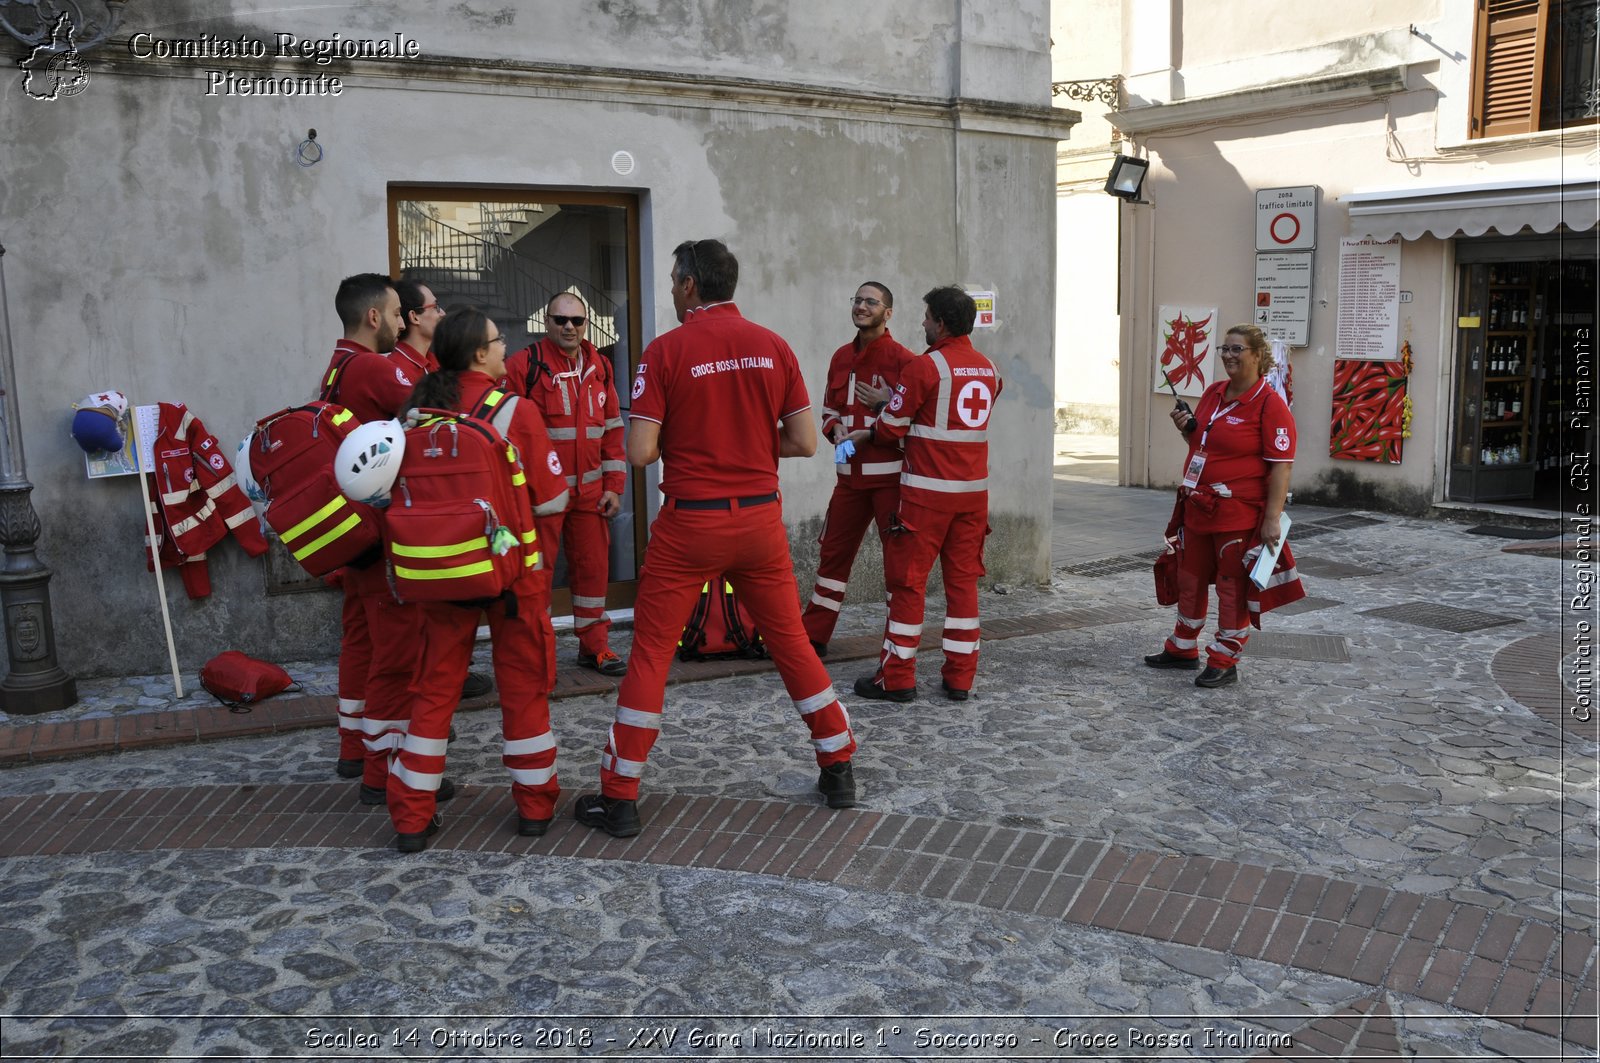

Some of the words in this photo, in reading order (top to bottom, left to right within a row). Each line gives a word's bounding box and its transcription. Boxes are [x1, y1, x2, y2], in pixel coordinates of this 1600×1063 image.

[1286, 200, 1312, 208] limitato
[691, 363, 715, 378] CROCE
[716, 359, 740, 372] ROSSA
[741, 357, 774, 370] ITALIANA
